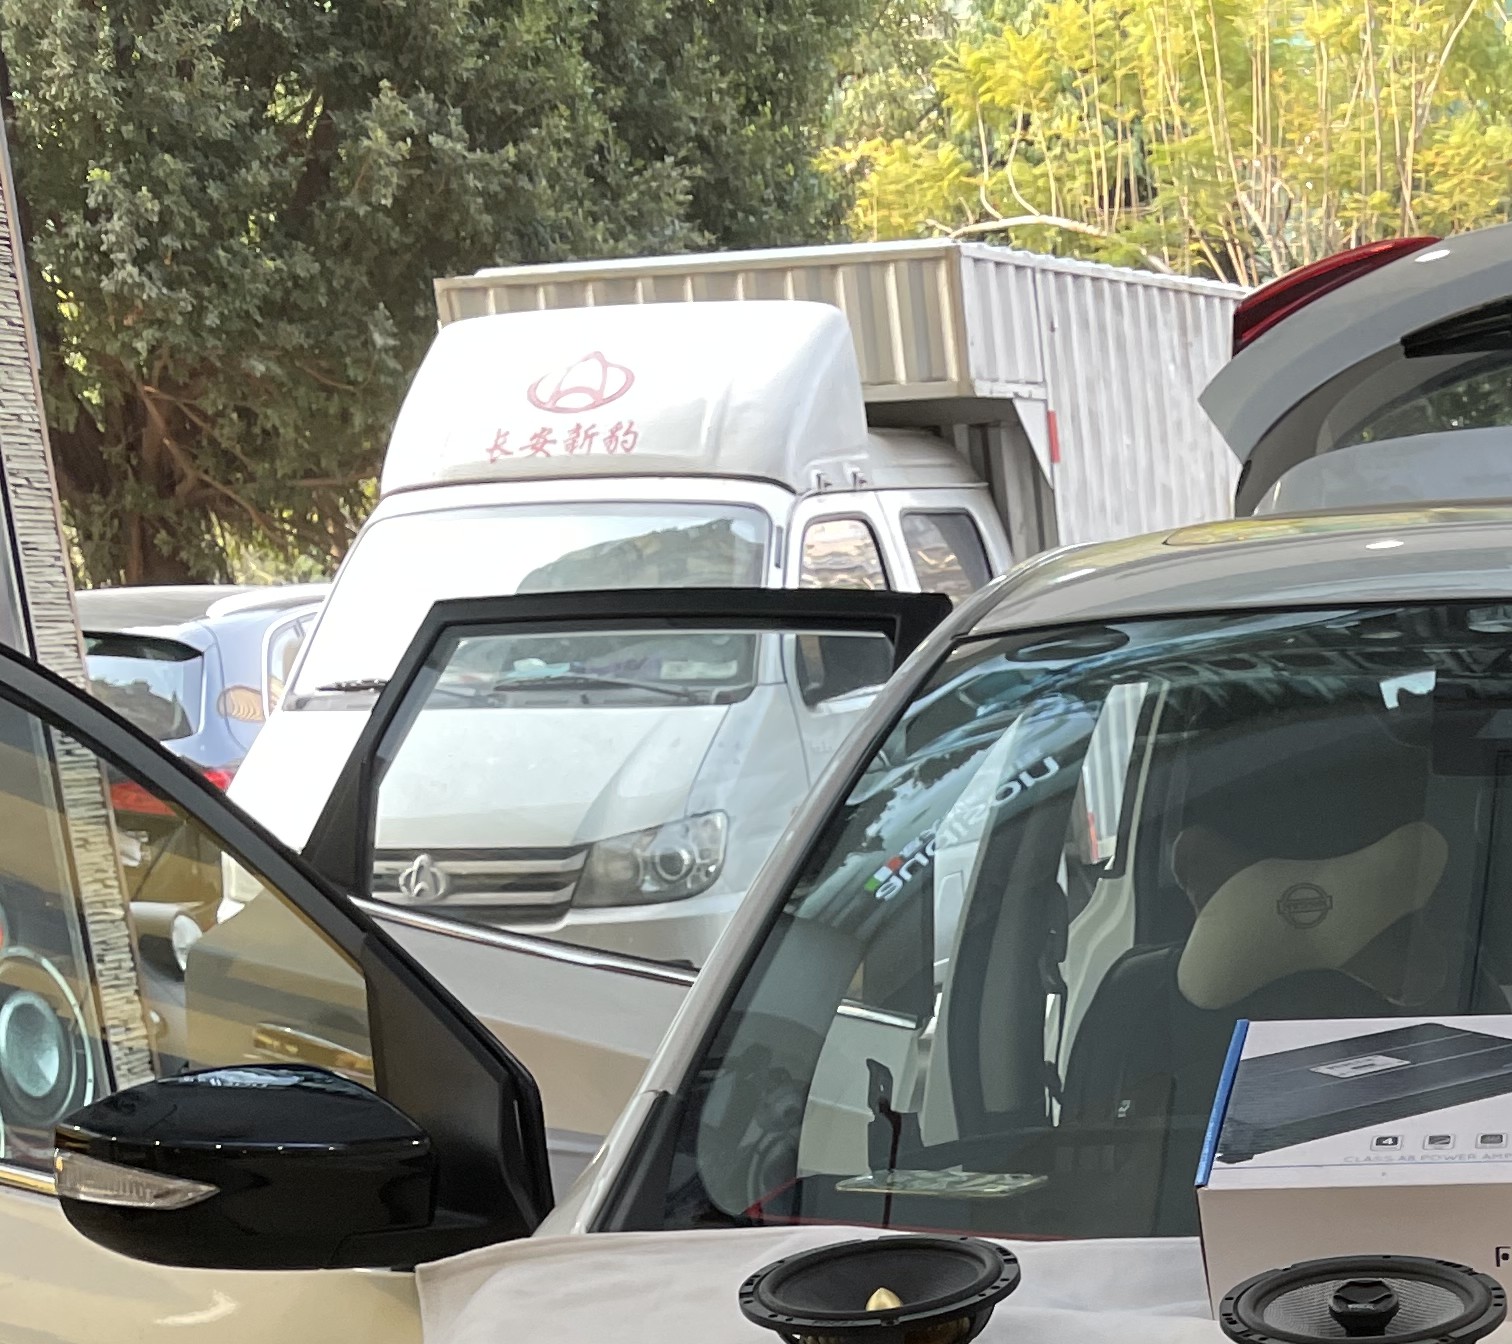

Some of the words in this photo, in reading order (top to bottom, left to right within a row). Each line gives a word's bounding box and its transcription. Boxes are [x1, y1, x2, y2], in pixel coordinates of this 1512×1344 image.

[485, 419, 640, 464] 长安新豹
[1343, 1154, 1393, 1164] CLASS
[1420, 1153, 1476, 1162] POWER
